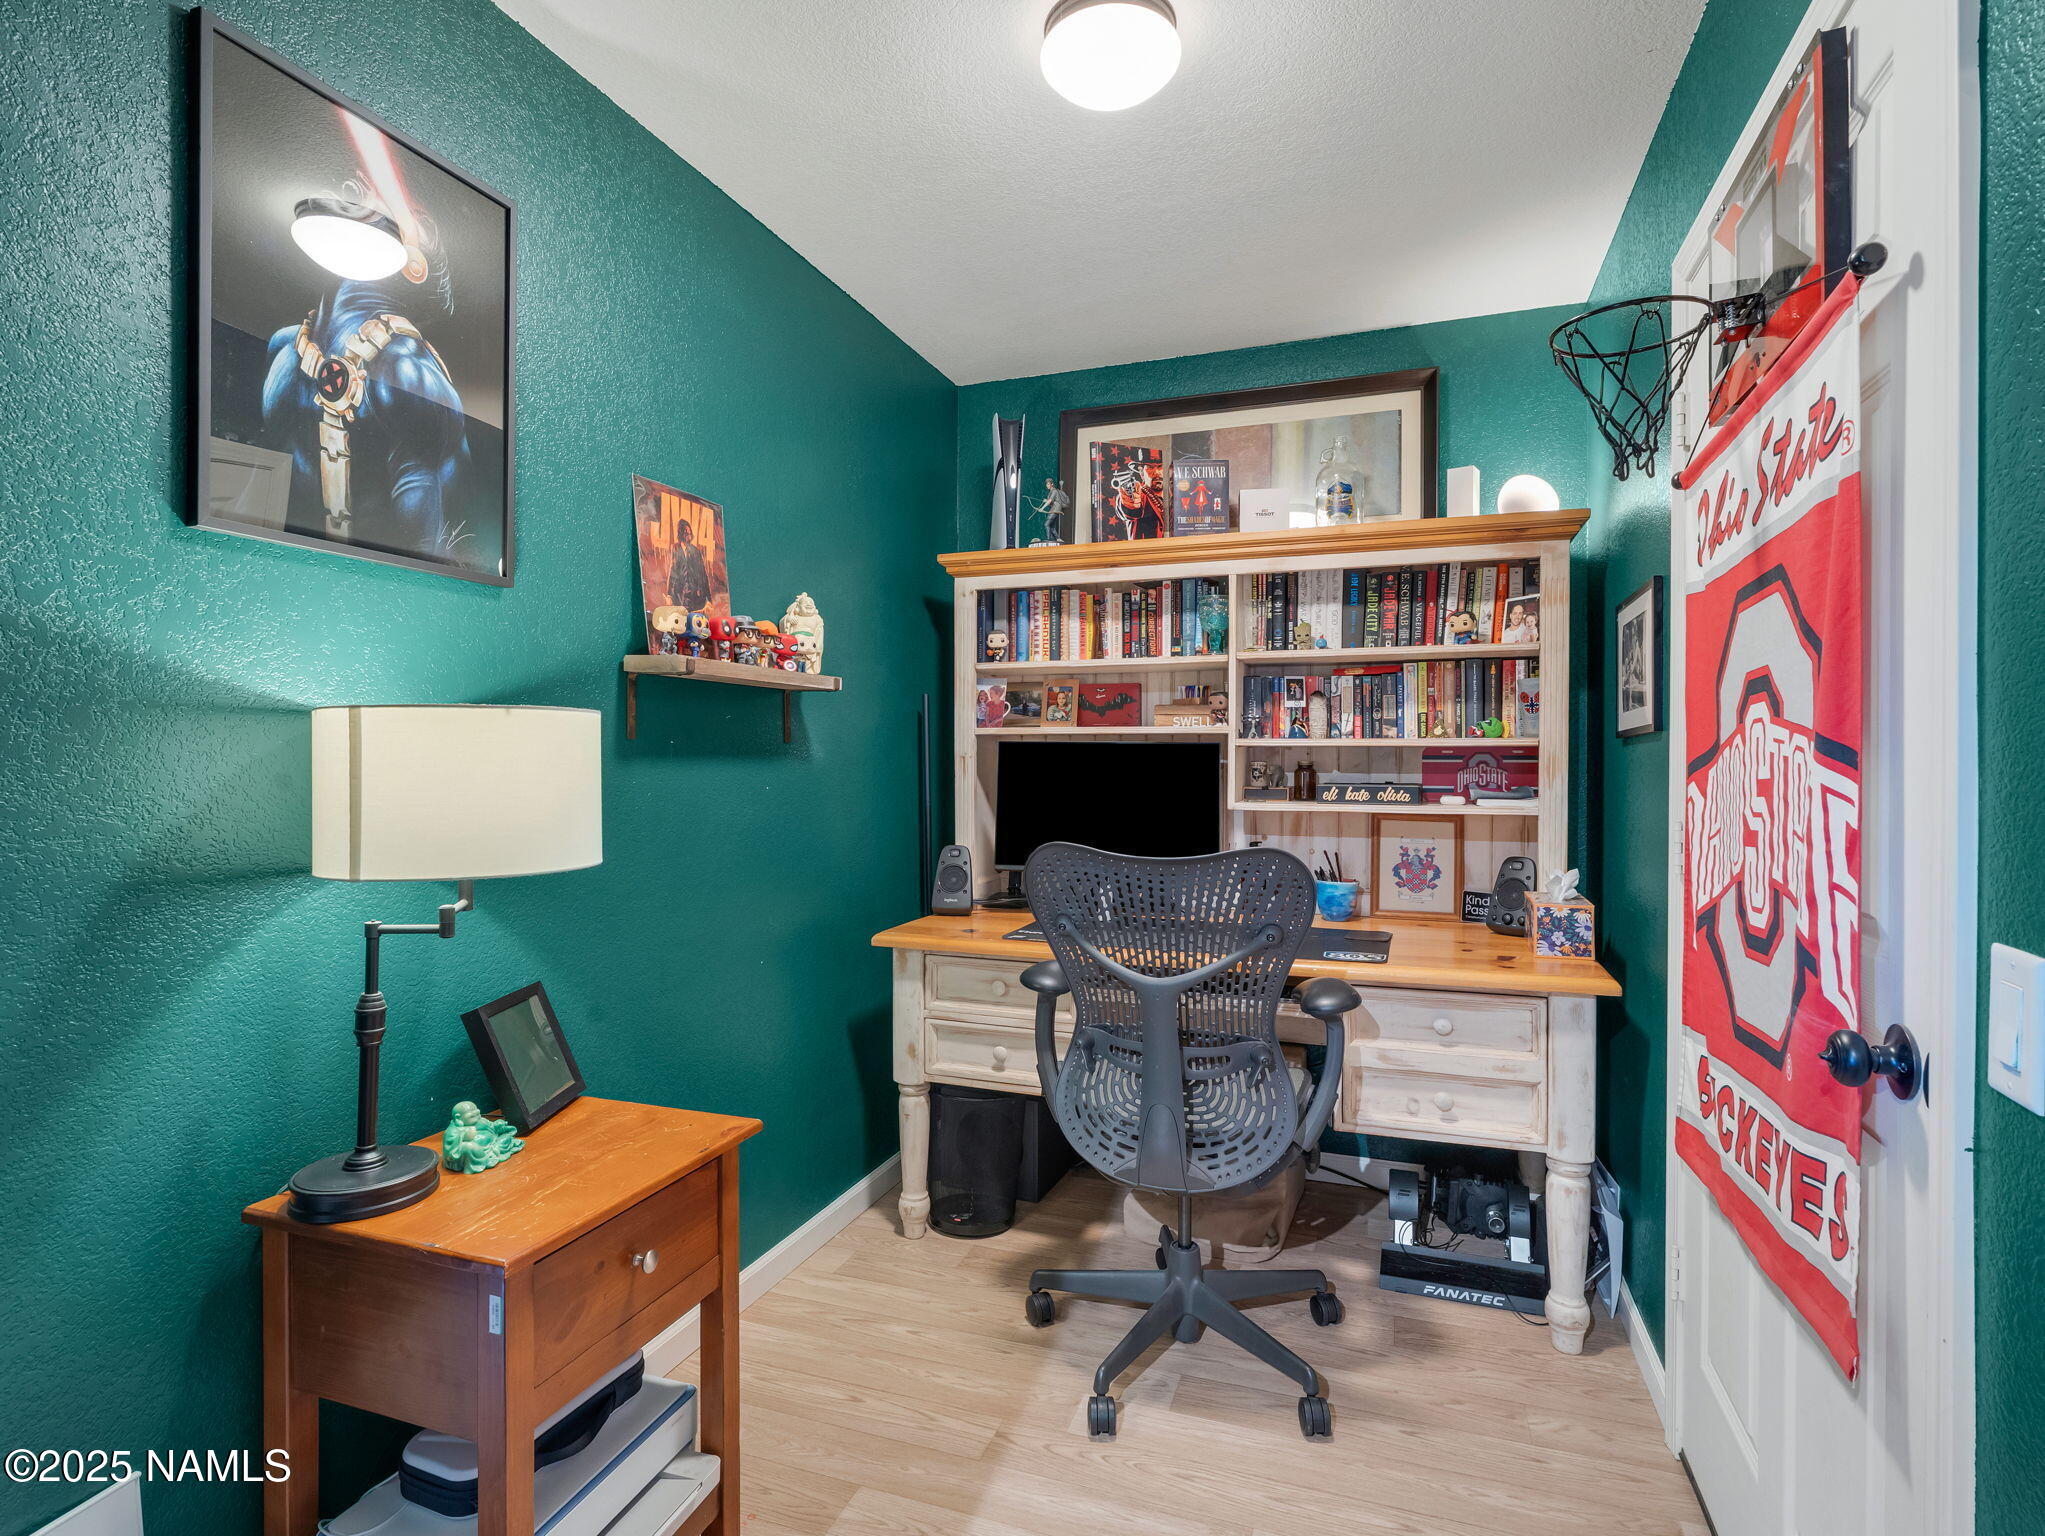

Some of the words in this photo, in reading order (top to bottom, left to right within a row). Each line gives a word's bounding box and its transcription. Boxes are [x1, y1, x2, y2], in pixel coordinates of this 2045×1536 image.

[1367, 591, 1379, 613] JADE
[1384, 587, 1396, 610] JADE
[1400, 584, 1409, 626] SCHWAB
[1366, 614, 1378, 632] CITY
[1383, 611, 1395, 630] WAR
[1414, 602, 1422, 640] VENGEFUL
[1148, 611, 1157, 655] CORRECTIONS
[1172, 715, 1212, 728] SWELL
[1457, 767, 1479, 793] OHIO
[1345, 786, 1370, 802] kate
[1697, 1054, 1850, 1262] BCKEYES
[1423, 1285, 1507, 1307] FANATEC
